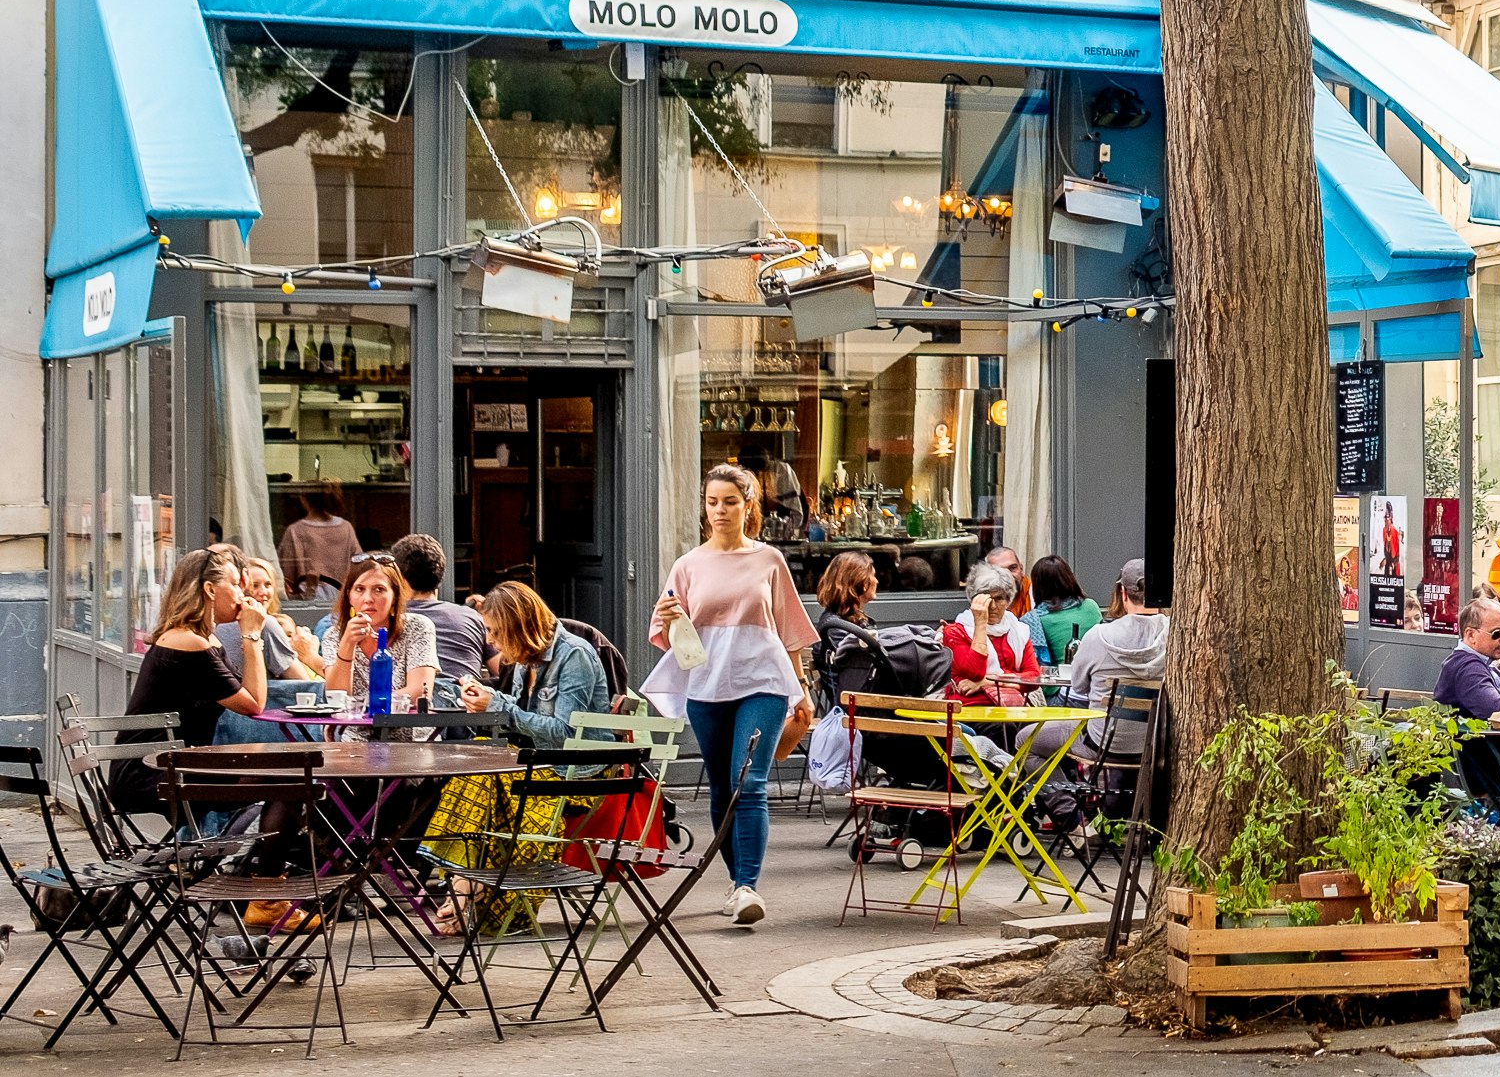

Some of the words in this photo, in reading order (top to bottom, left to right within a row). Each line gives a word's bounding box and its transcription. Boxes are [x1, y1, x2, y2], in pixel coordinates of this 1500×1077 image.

[588, 0, 676, 28] MOLO
[694, 5, 778, 35] MOLO
[1084, 46, 1140, 58] RESTAURANT
[1333, 515, 1351, 524] RATION
